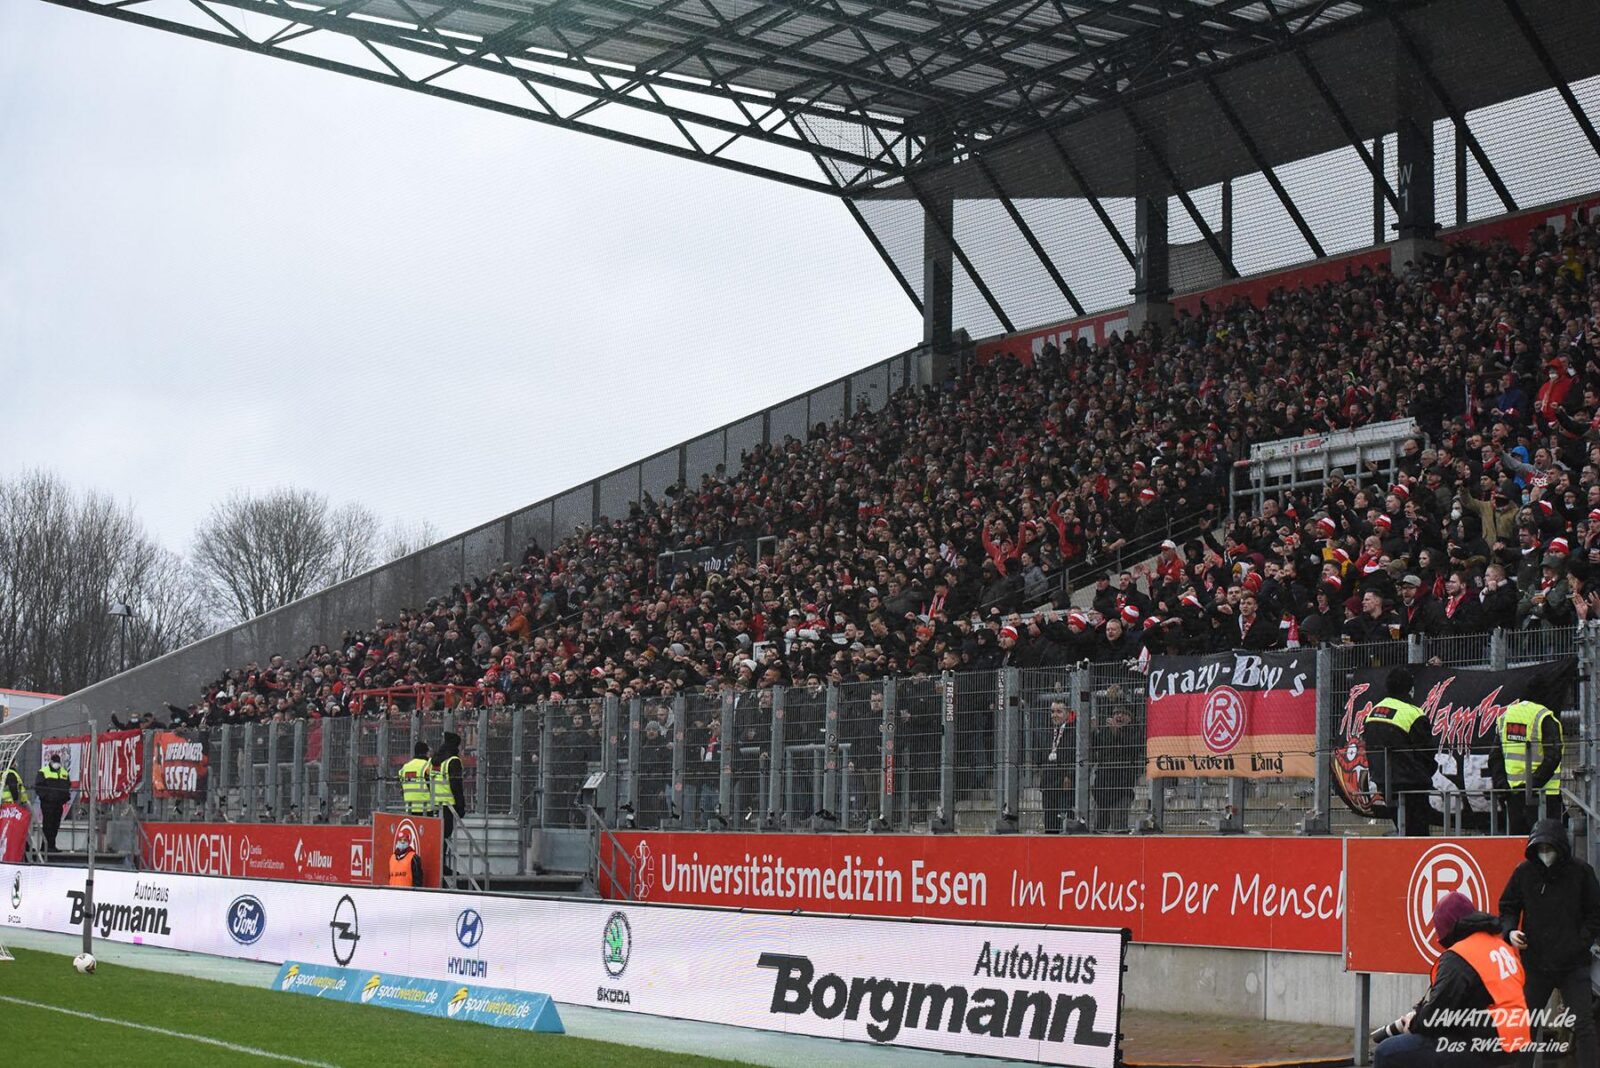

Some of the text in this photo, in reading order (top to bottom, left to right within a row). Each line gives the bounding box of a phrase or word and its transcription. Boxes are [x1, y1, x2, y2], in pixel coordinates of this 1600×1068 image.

[153, 832, 232, 876] CHANCEN
[306, 850, 333, 869] Allbau
[134, 880, 170, 903] Autohaus
[661, 852, 902, 902] Universitätsmedizin
[911, 860, 987, 906] Essen
[1010, 869, 1046, 906] Im
[1058, 865, 1146, 912] Fokus:
[1161, 871, 1219, 914] Der
[233, 902, 259, 936] Ford
[447, 956, 488, 979] HYUNDAI
[974, 941, 1098, 985] Autohaus
[1489, 945, 1519, 981] 28
[295, 973, 347, 991] sportwetten.de
[377, 984, 439, 1004] sportwetten.de
[464, 996, 530, 1018] sportwetten.de
[756, 951, 1114, 1048] Borgmann
